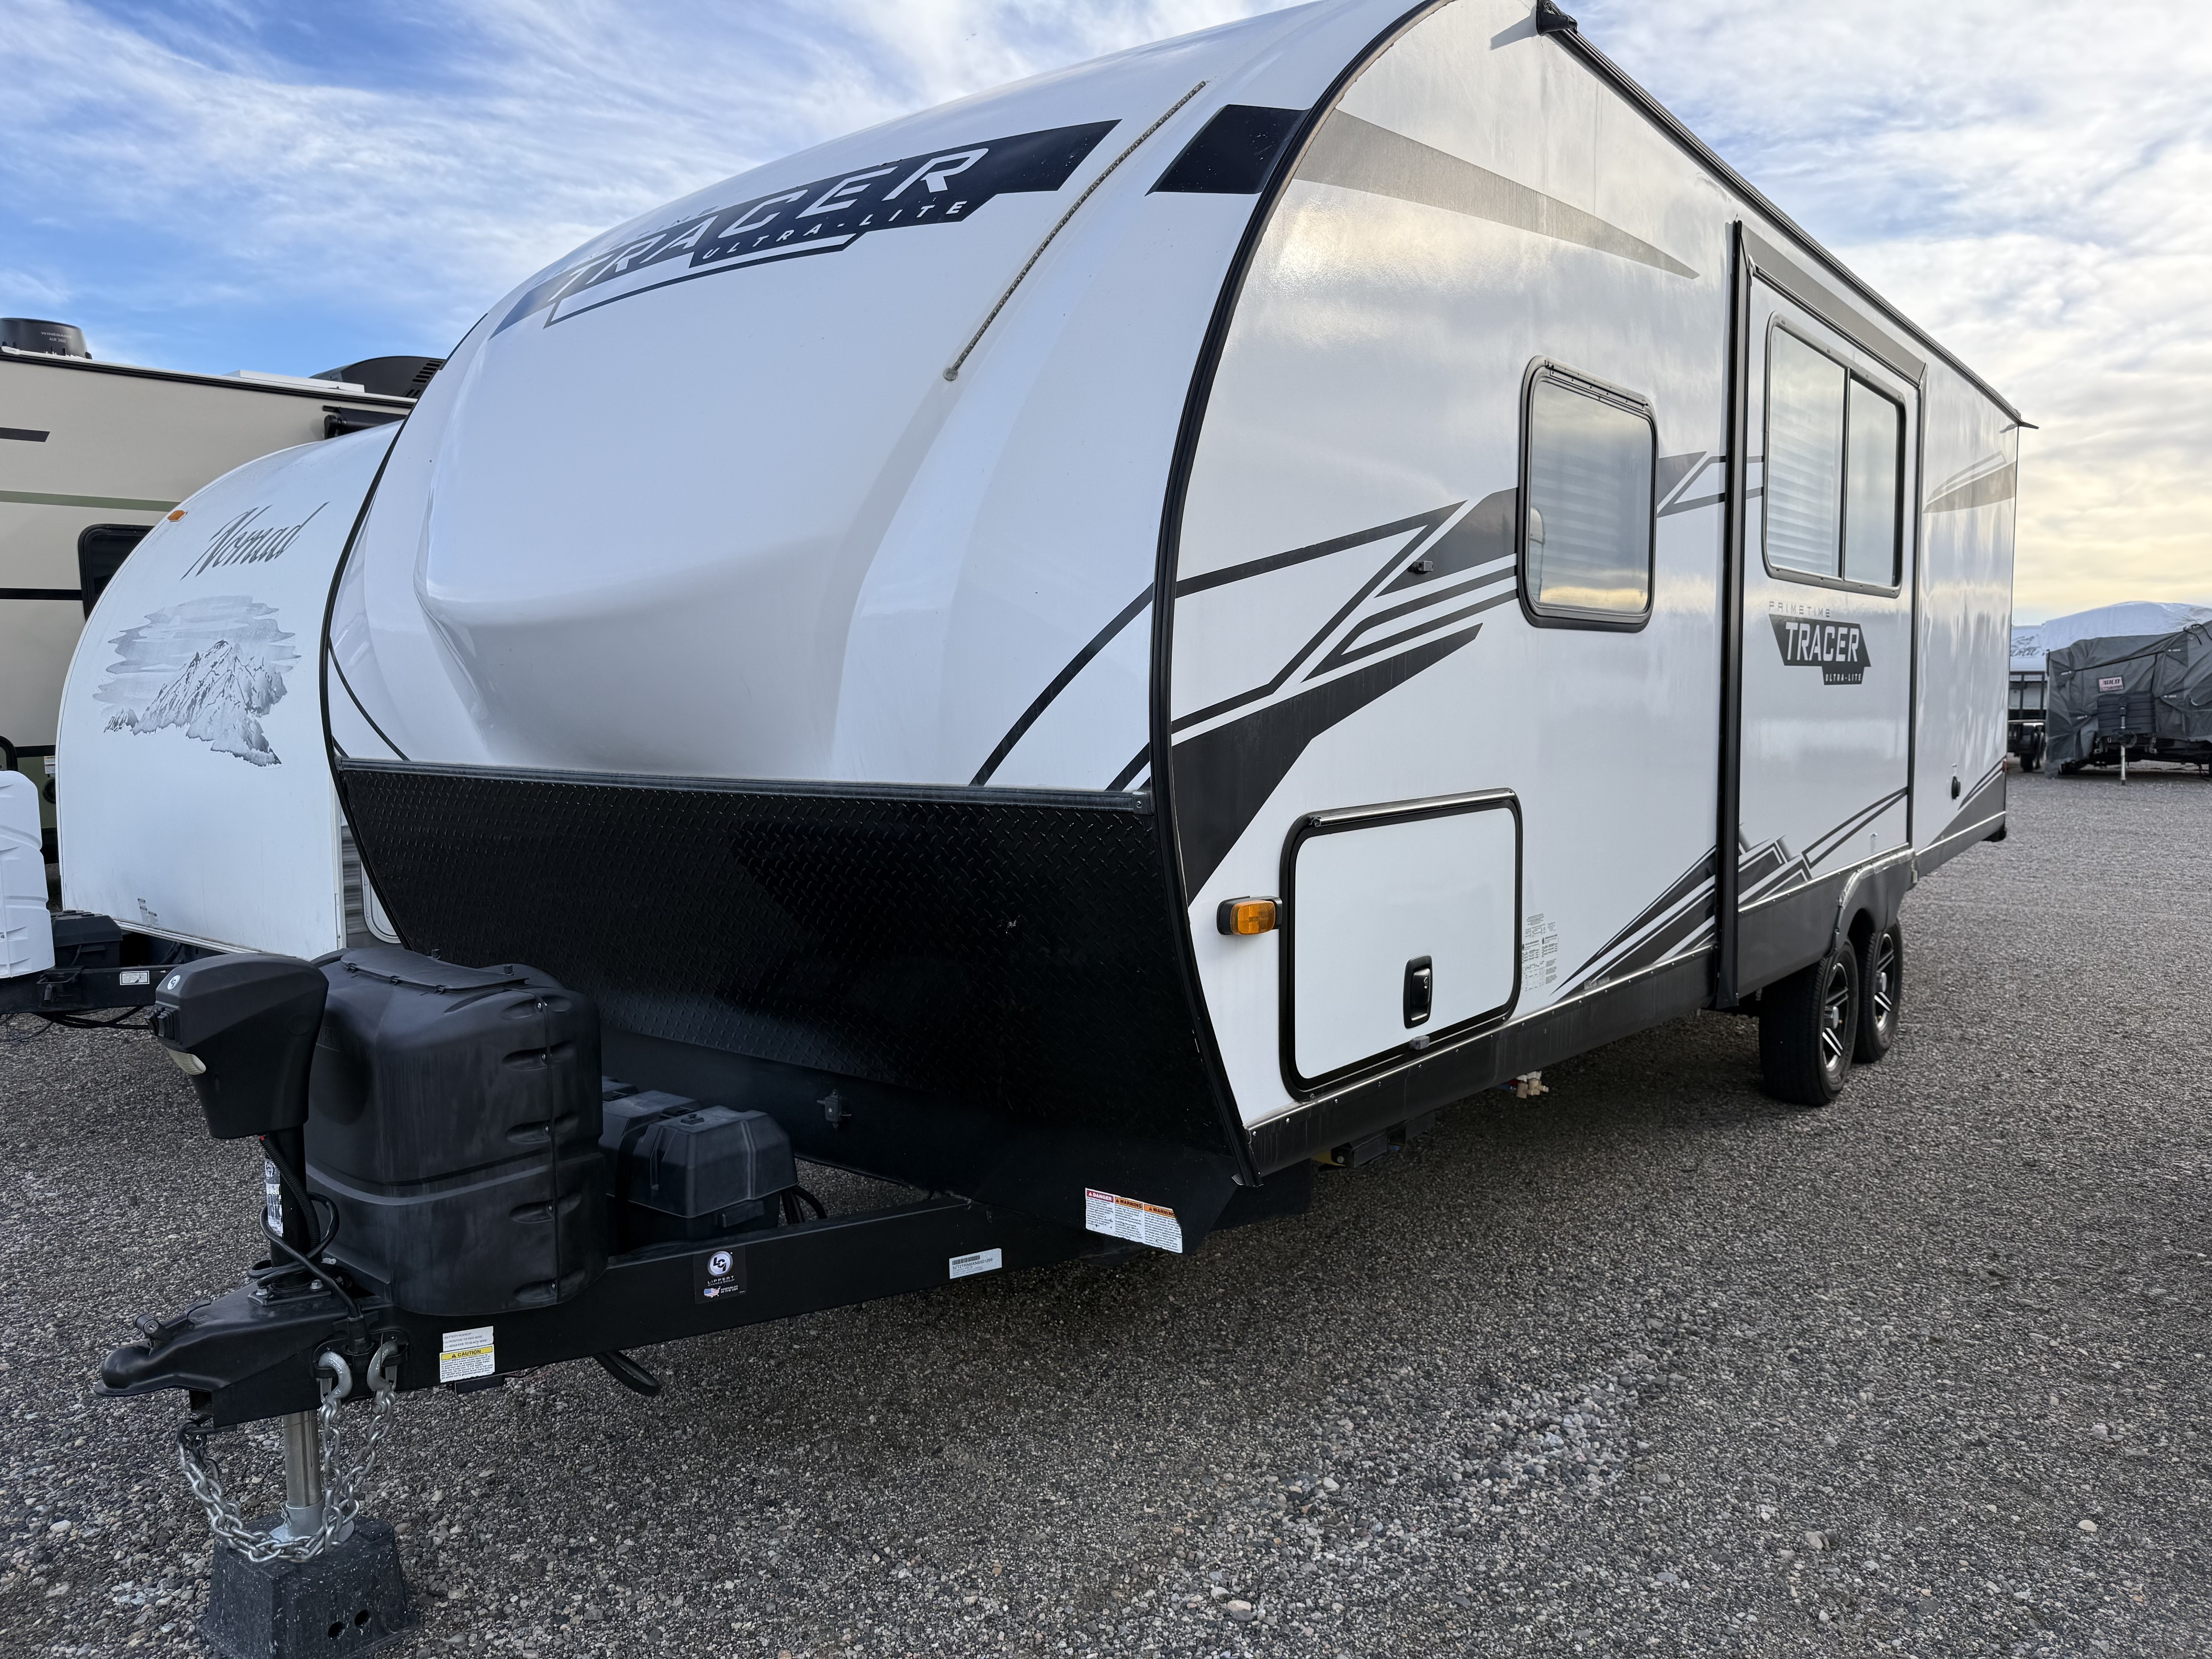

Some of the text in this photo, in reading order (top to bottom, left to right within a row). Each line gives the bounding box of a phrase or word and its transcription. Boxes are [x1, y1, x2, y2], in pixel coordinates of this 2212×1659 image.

[547, 148, 989, 302] TRACER
[702, 201, 968, 260] ULTRA-LITE
[180, 501, 330, 580] Nomad
[1769, 601, 1830, 617] PRIMETIME
[1785, 622, 1859, 662] TRACER
[1825, 673, 1861, 682] ULTRA-LITE
[1092, 1192, 1112, 1201] DANGER
[1120, 1199, 1142, 1208] WARNING
[708, 1276, 734, 1284] LIPPERT
